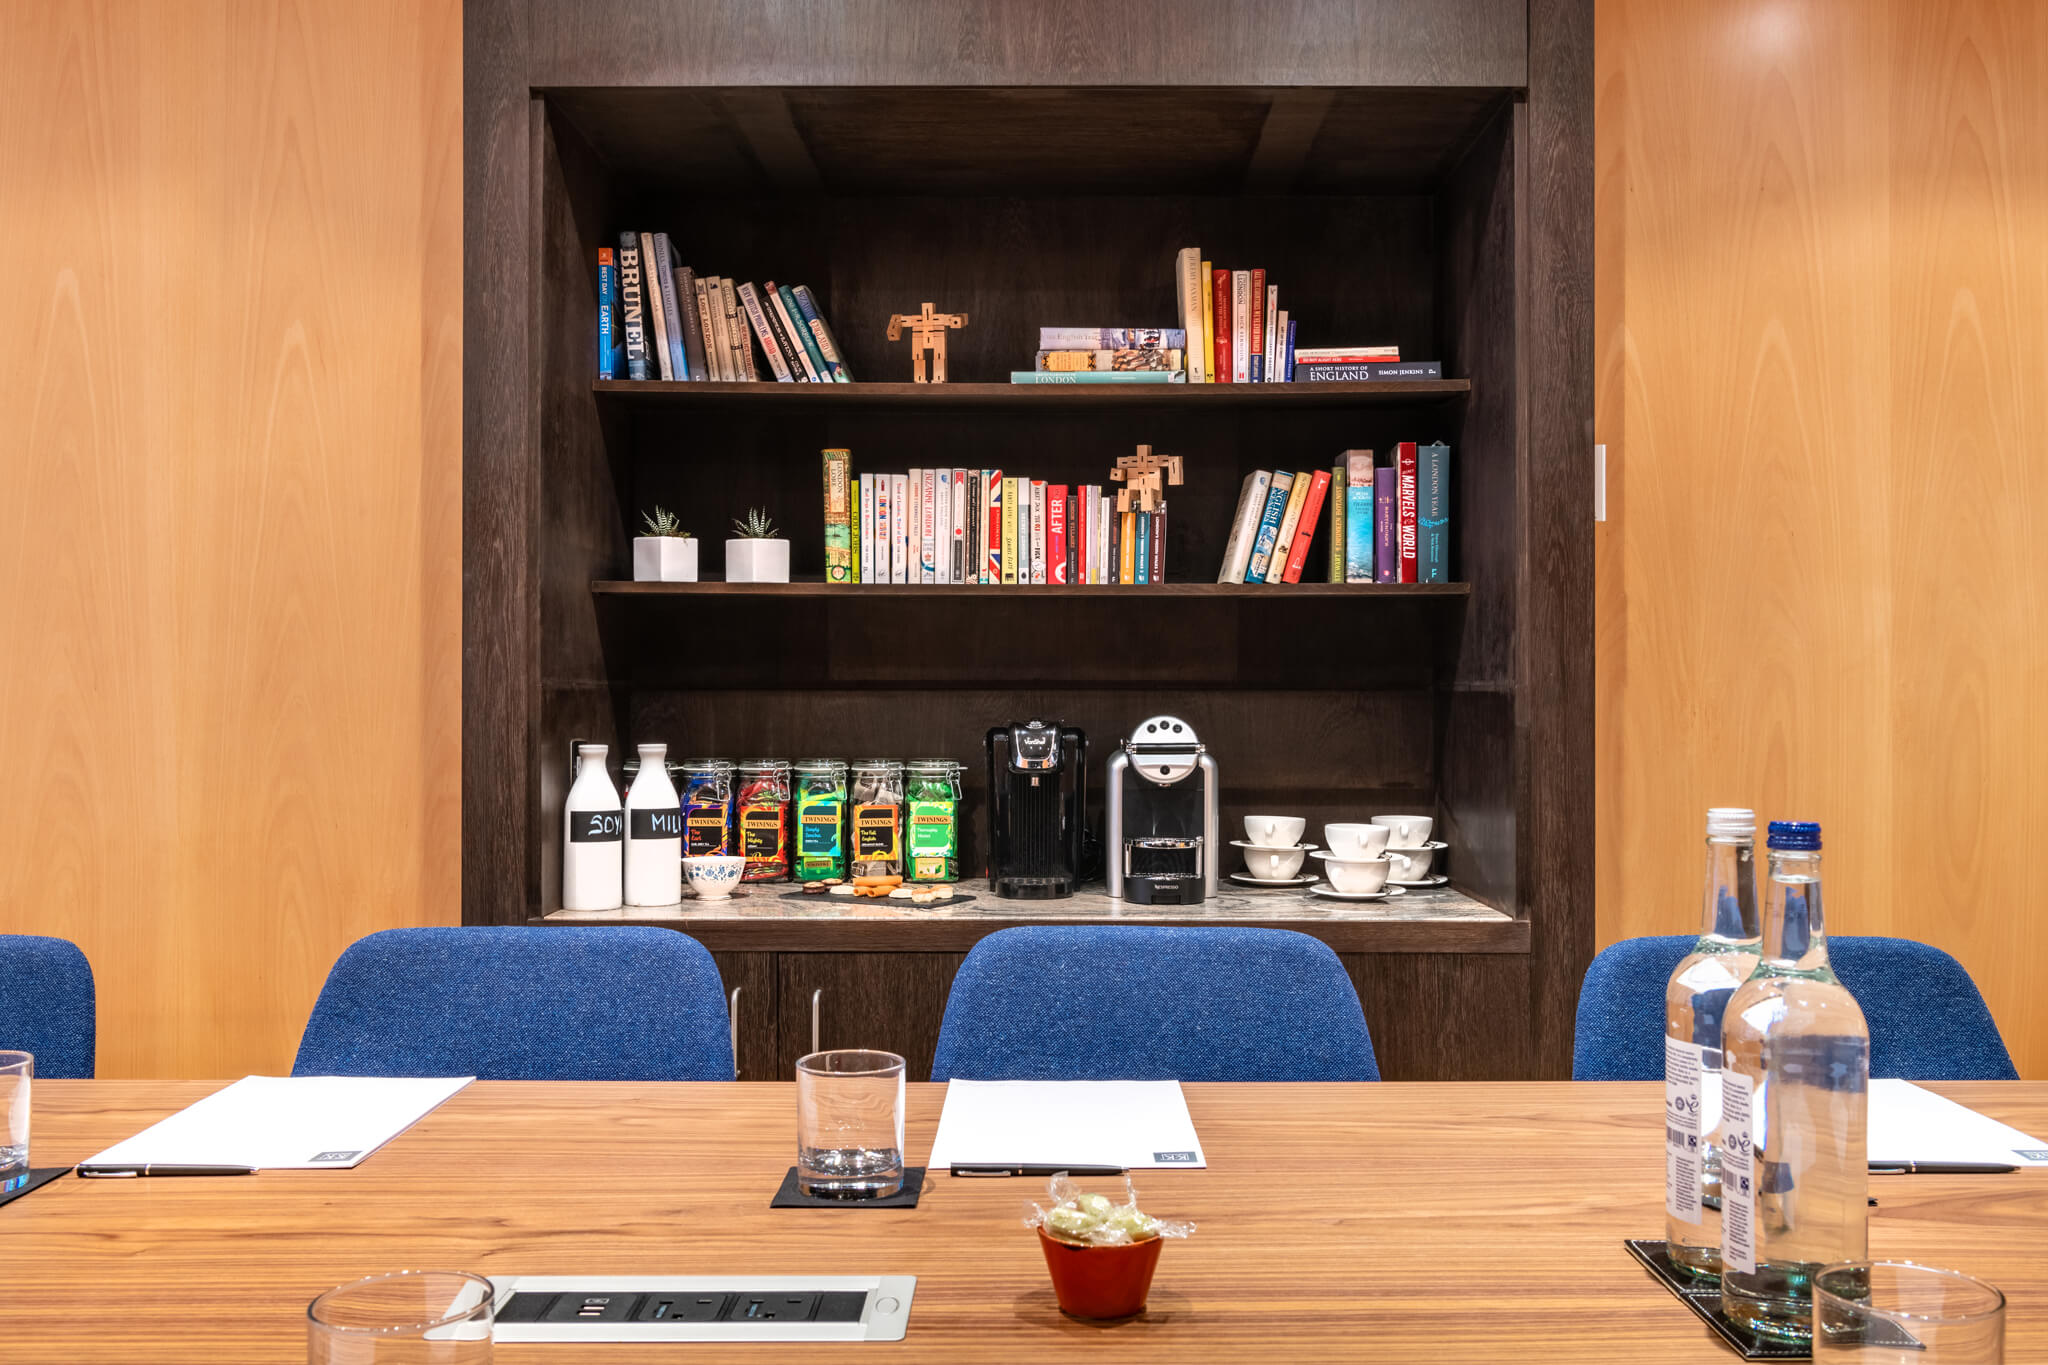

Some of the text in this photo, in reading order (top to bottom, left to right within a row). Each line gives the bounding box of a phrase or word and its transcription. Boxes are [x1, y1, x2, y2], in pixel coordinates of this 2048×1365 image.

[620, 248, 644, 360] BRUNEL
[741, 286, 752, 298] VERY
[746, 297, 759, 316] BRITISH
[601, 305, 609, 334] EARTH
[703, 318, 712, 349] LONDON
[753, 314, 769, 338] PROBLEMS
[1310, 371, 1369, 381] ENGLAND
[879, 496, 887, 519] LONDON
[1051, 500, 1063, 534] AFTER
[1269, 488, 1285, 524] NGLISH
[1402, 475, 1415, 559] MARVELS WORLD
[924, 506, 932, 536] LONDON
[651, 814, 681, 834] MIL
